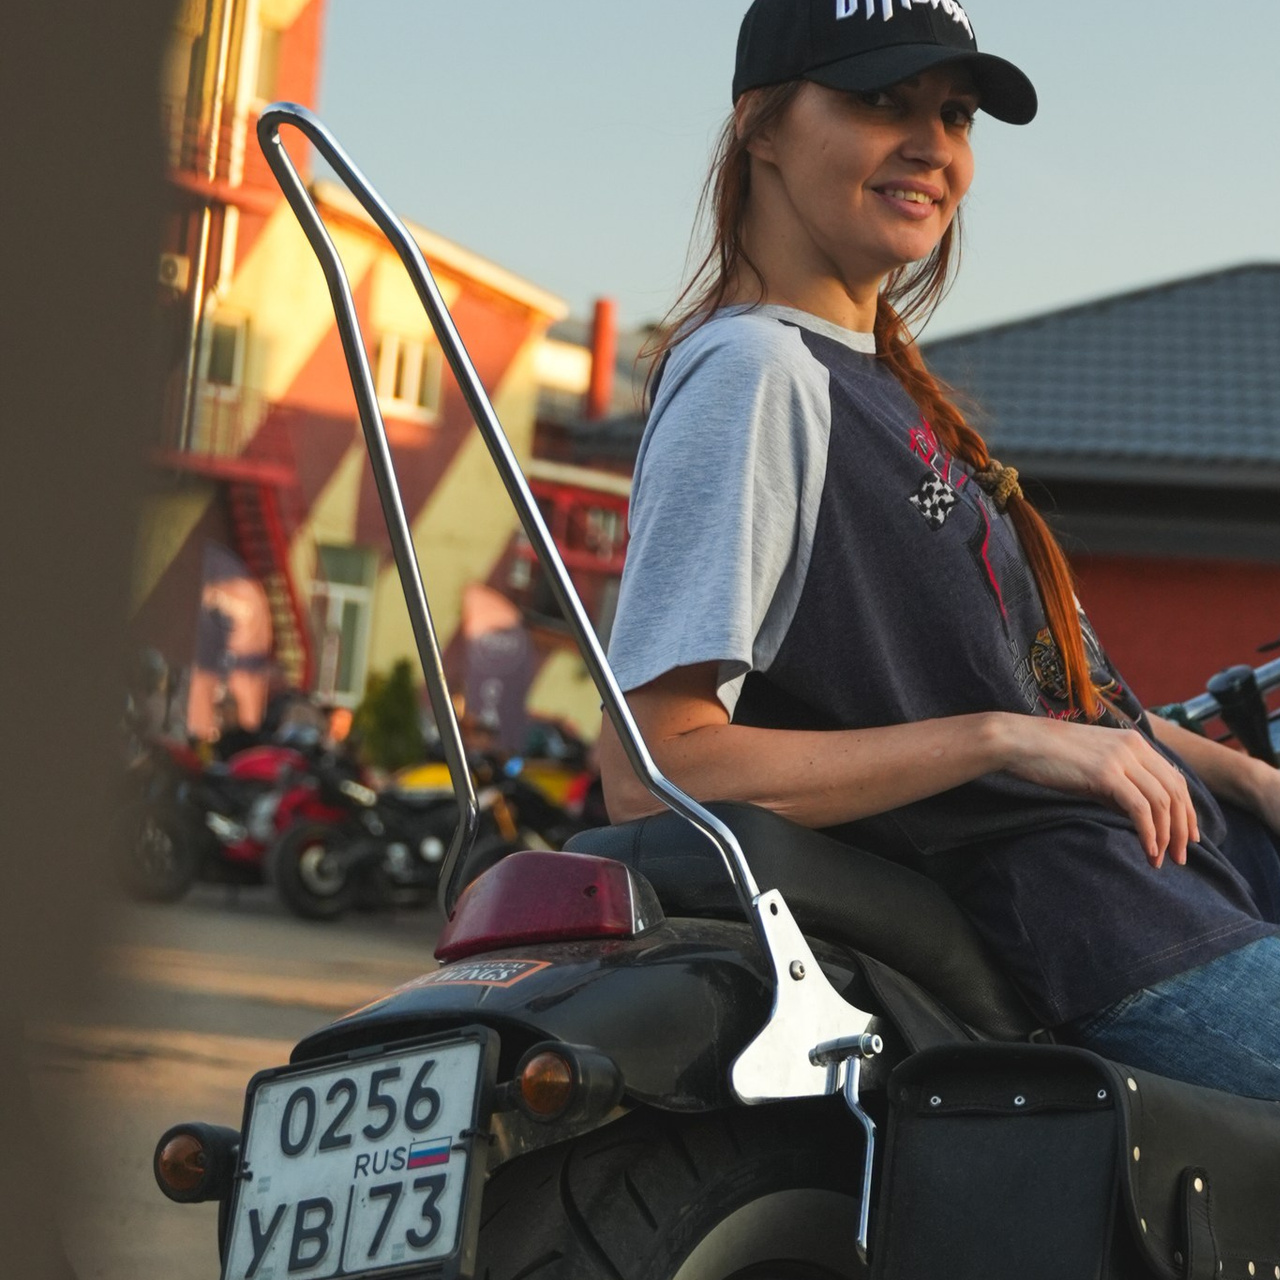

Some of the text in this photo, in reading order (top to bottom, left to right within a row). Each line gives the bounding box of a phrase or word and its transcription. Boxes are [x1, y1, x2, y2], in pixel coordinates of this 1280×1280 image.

[280, 1059, 441, 1157] 0256
[353, 1146, 407, 1179] RUS
[367, 1173, 447, 1258] 73
